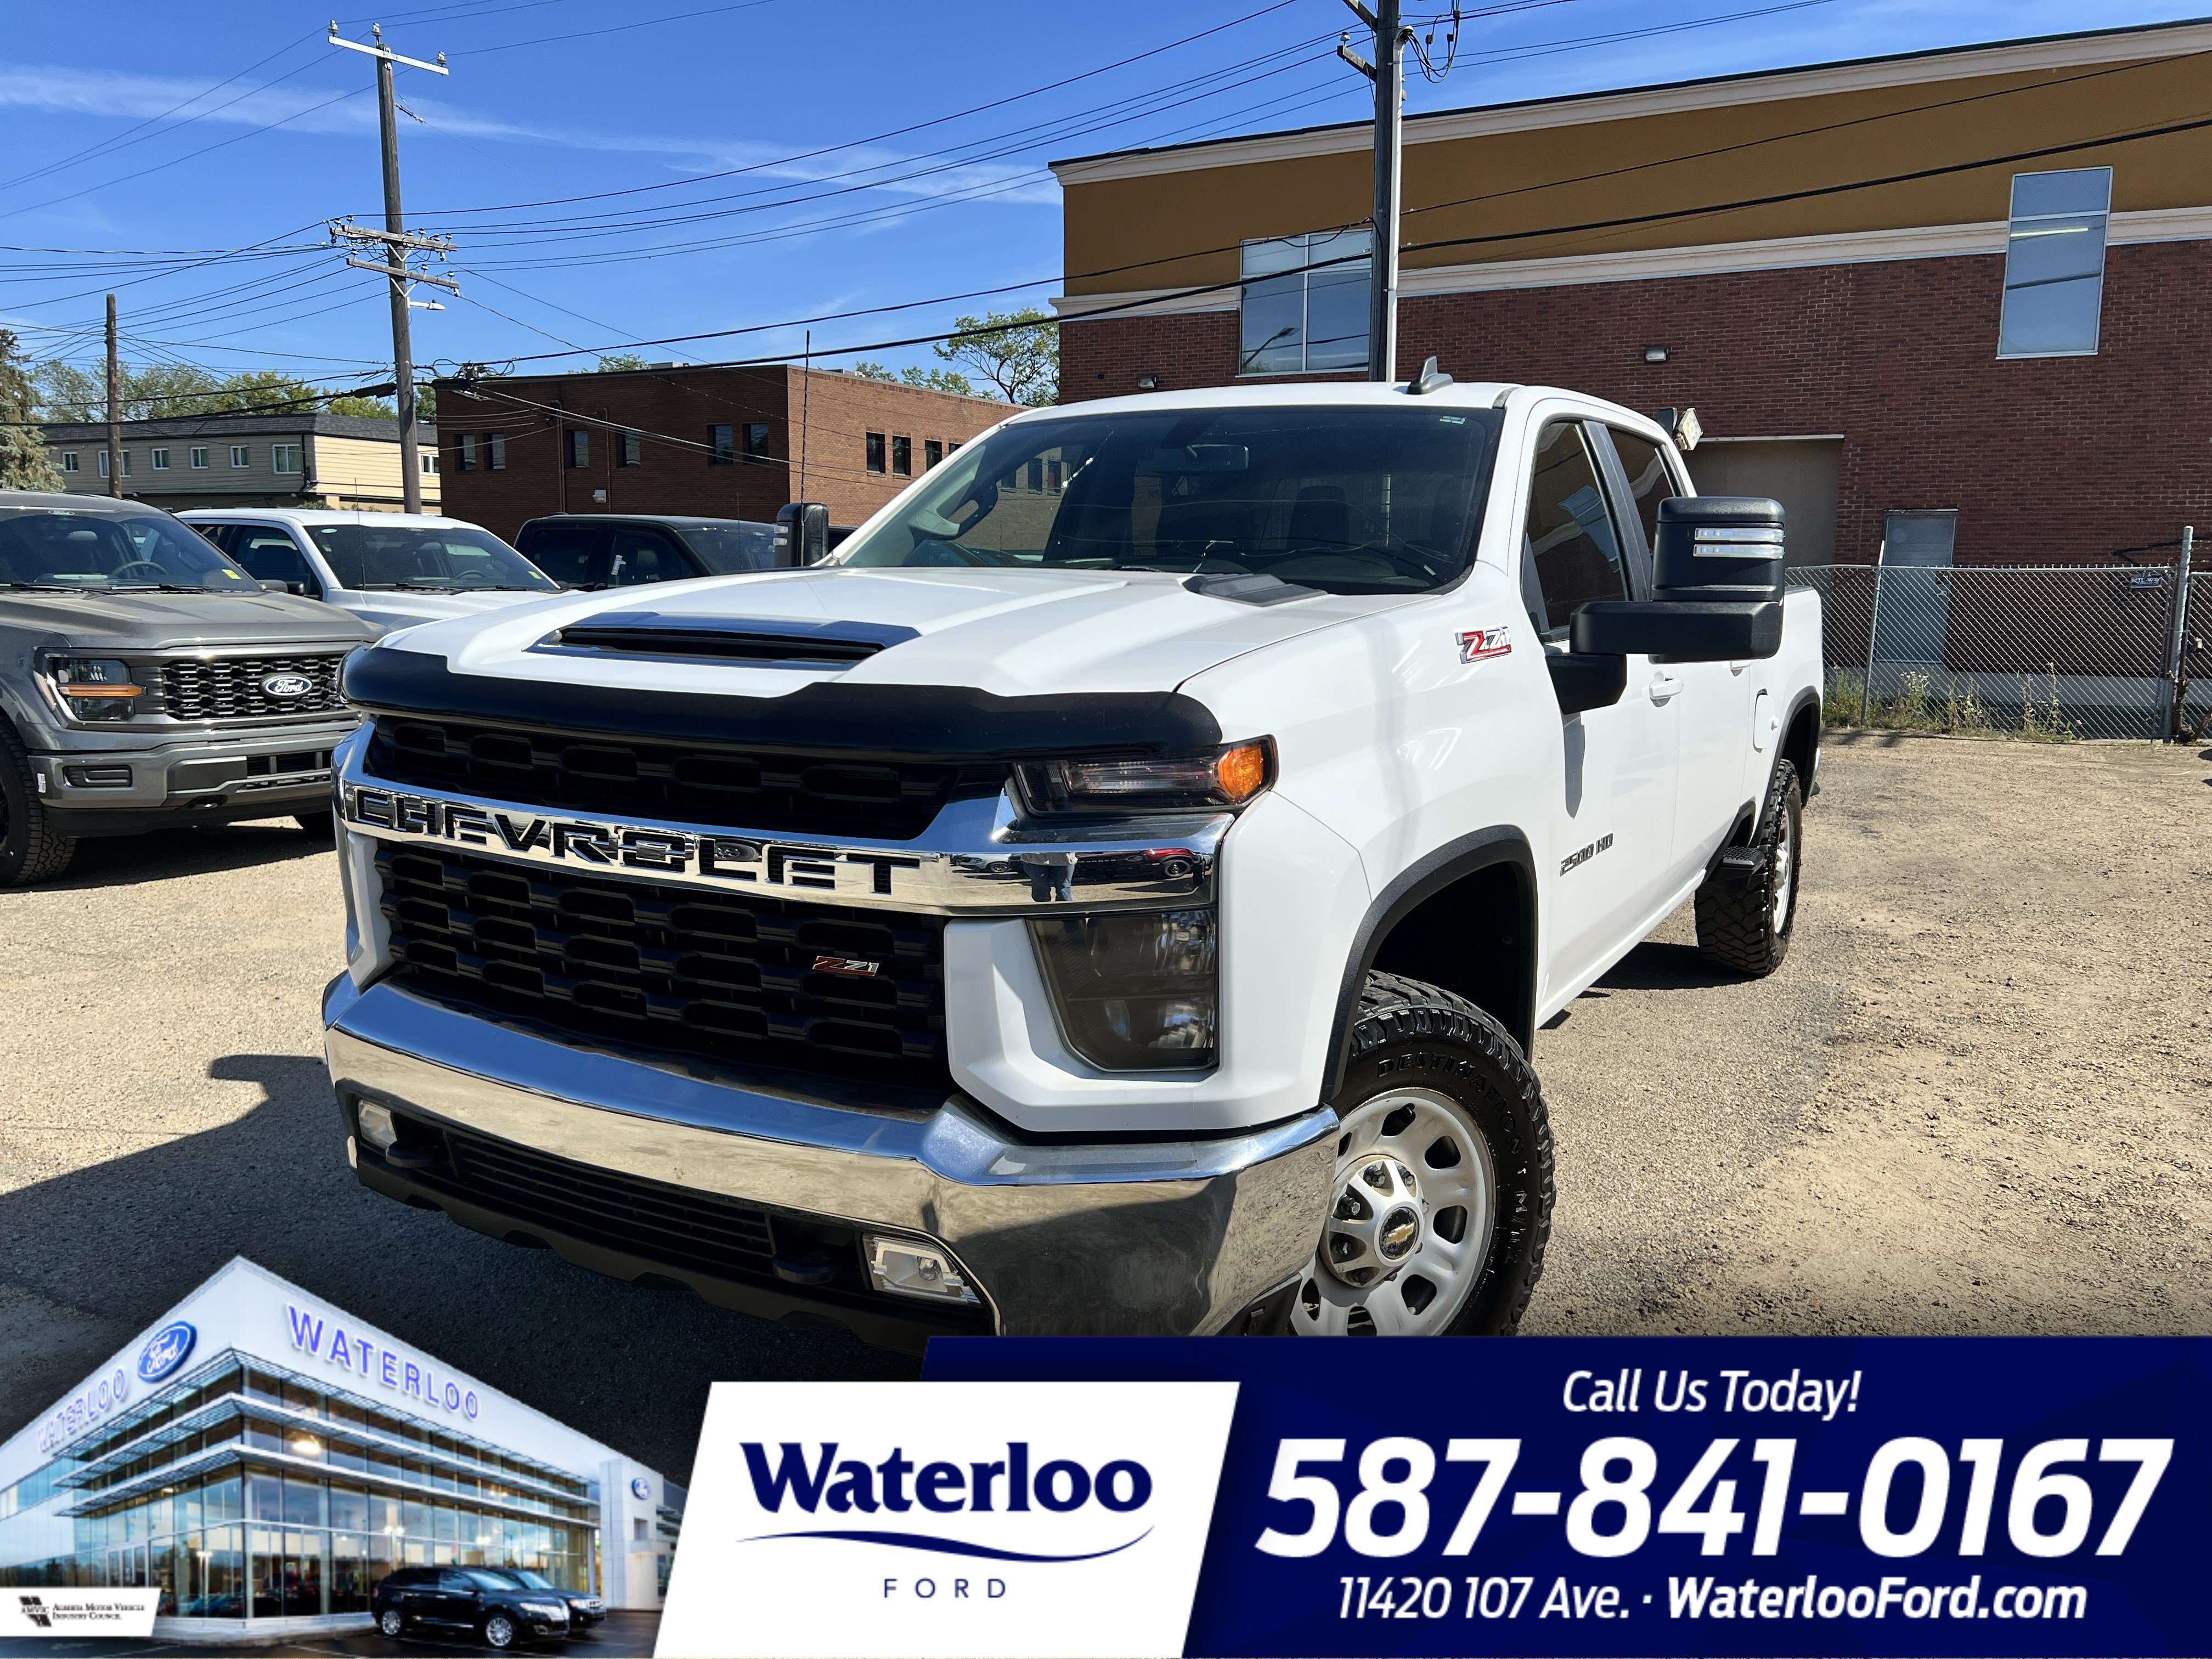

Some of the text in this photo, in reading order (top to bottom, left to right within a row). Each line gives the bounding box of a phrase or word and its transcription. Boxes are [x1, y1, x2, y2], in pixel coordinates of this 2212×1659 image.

[275, 679, 303, 693] Ford
[354, 786, 921, 895] CHEVROLET
[1560, 833, 1613, 877] 2500 HD
[812, 956, 879, 977] Z71
[1377, 1051, 1524, 1155] DESTINATION
